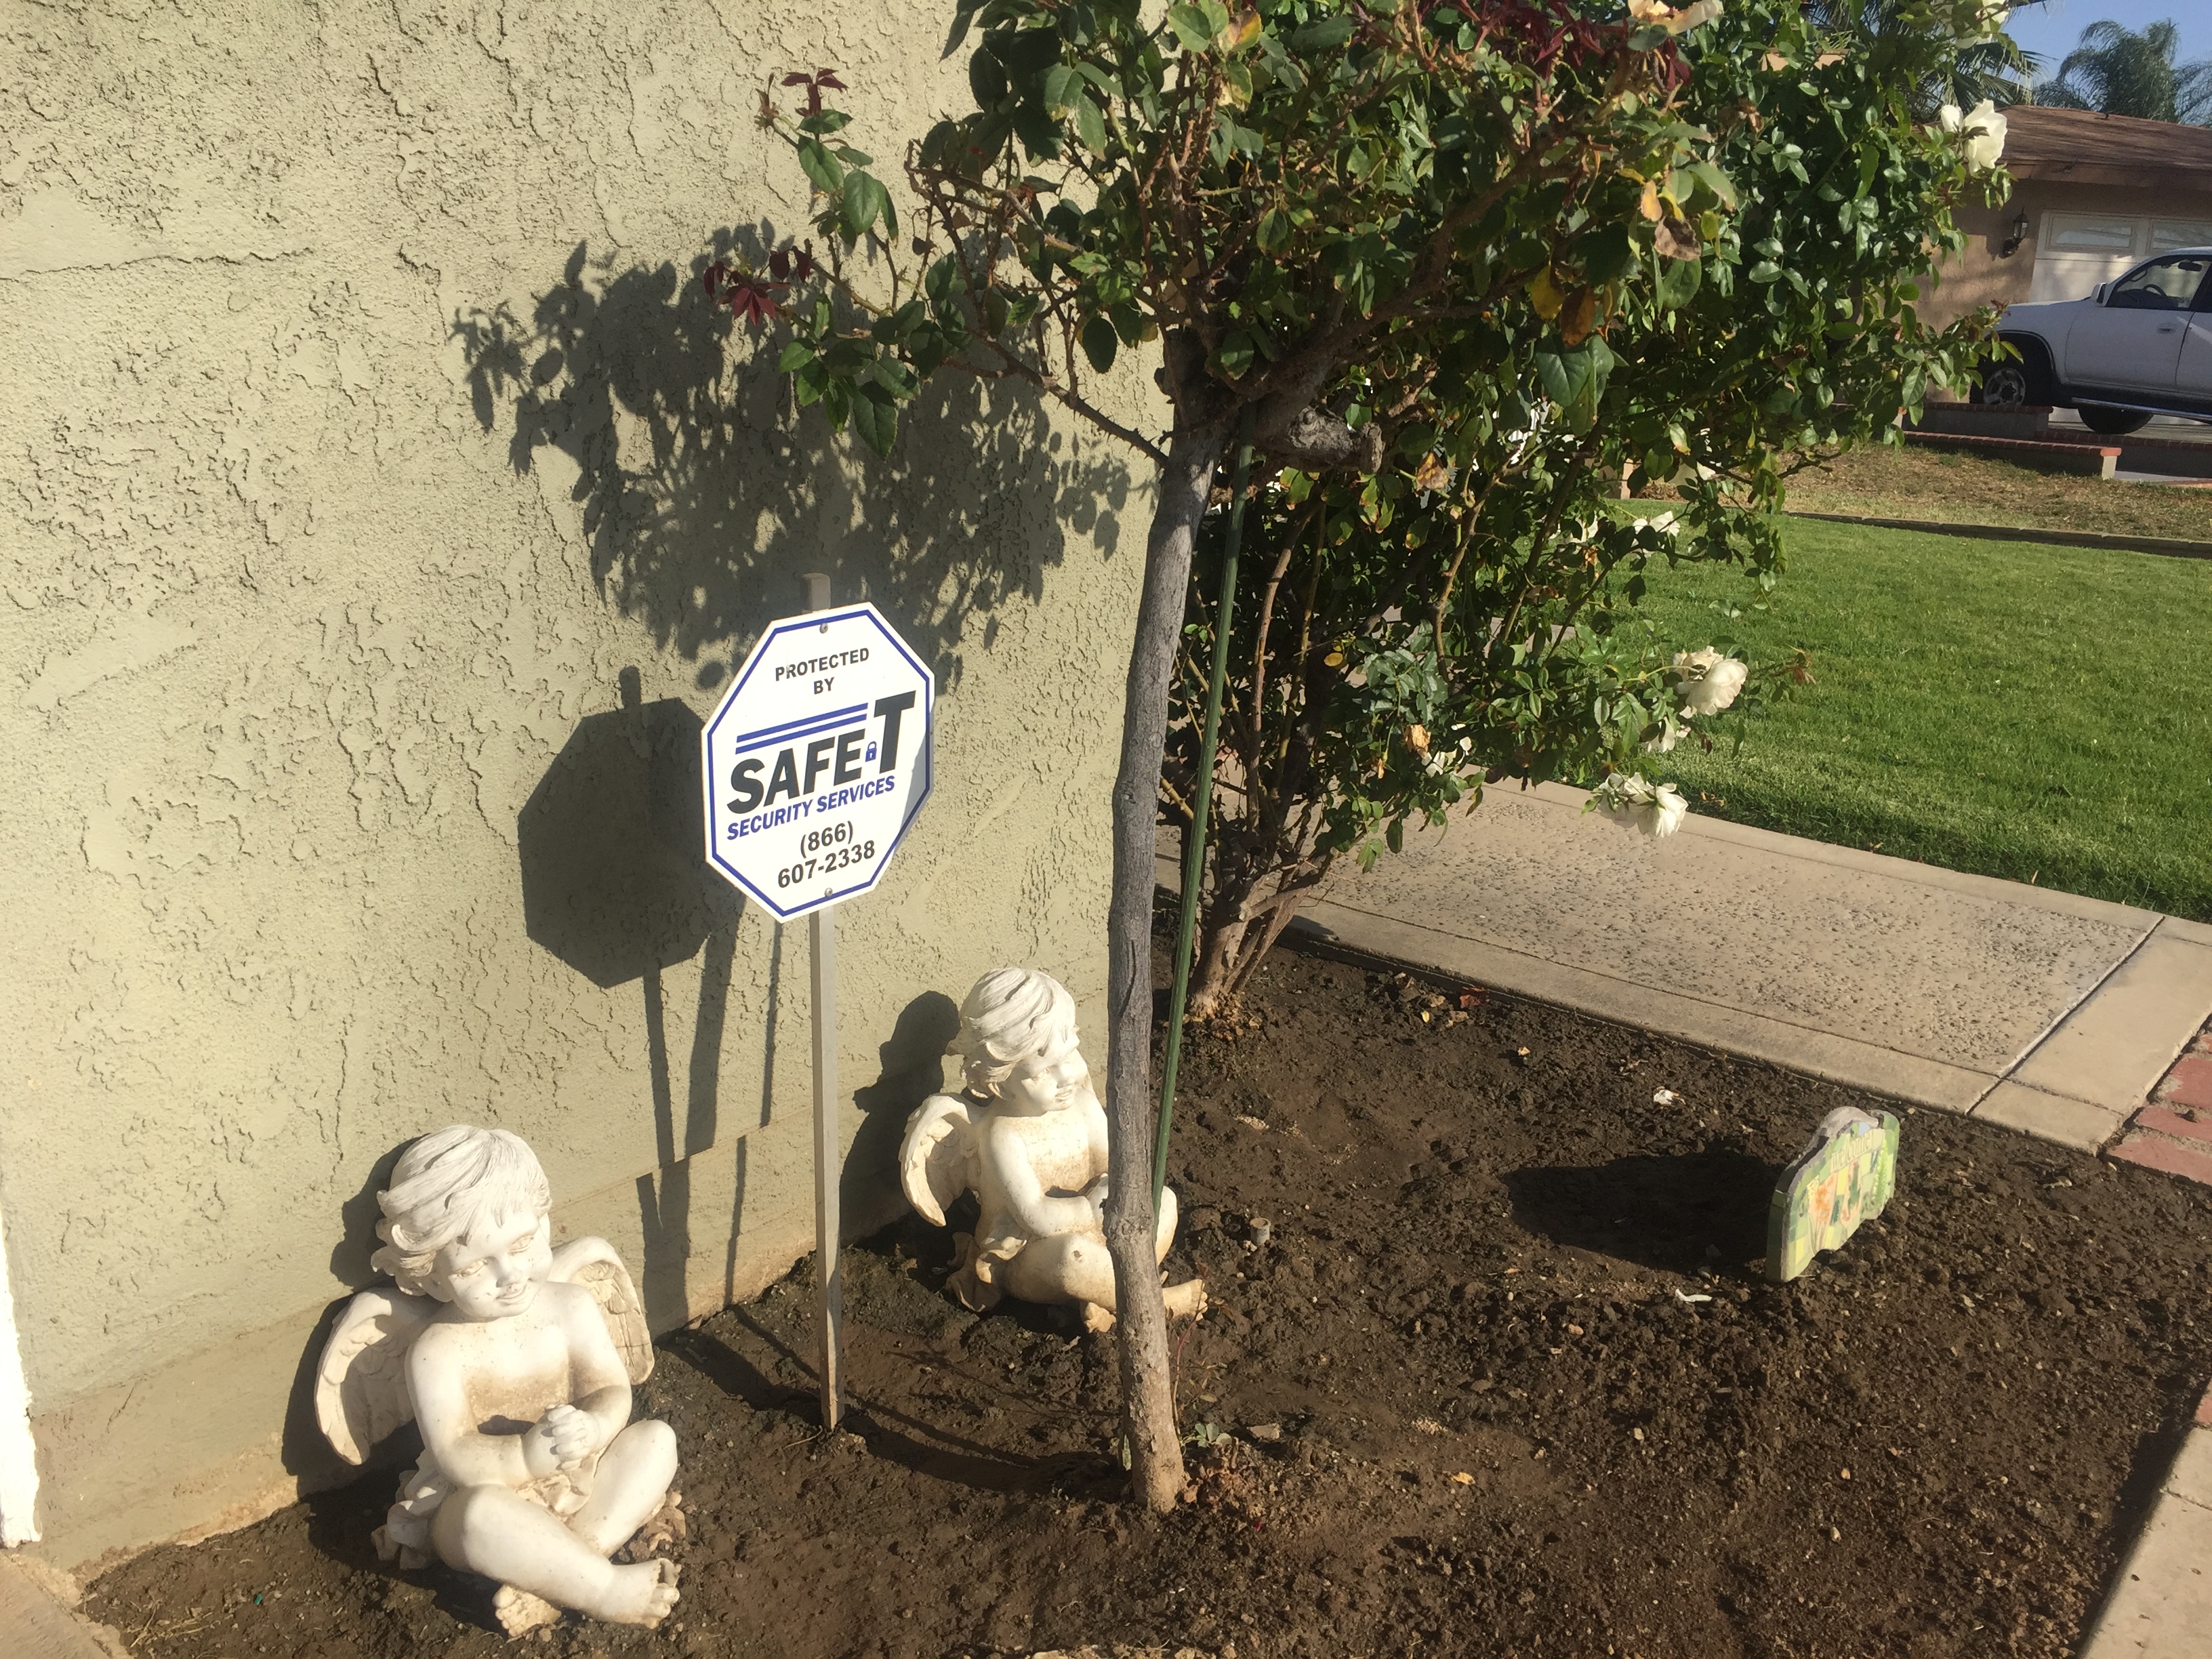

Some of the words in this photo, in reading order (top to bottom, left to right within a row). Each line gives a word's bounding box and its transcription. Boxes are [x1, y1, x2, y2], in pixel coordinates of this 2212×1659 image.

[775, 647, 869, 682] PROTECTED
[813, 677, 836, 695] BY
[726, 799, 814, 840] SECURITY
[816, 775, 895, 813] SERVICES
[800, 820, 854, 858] (866)
[777, 840, 876, 888] 607-2338
